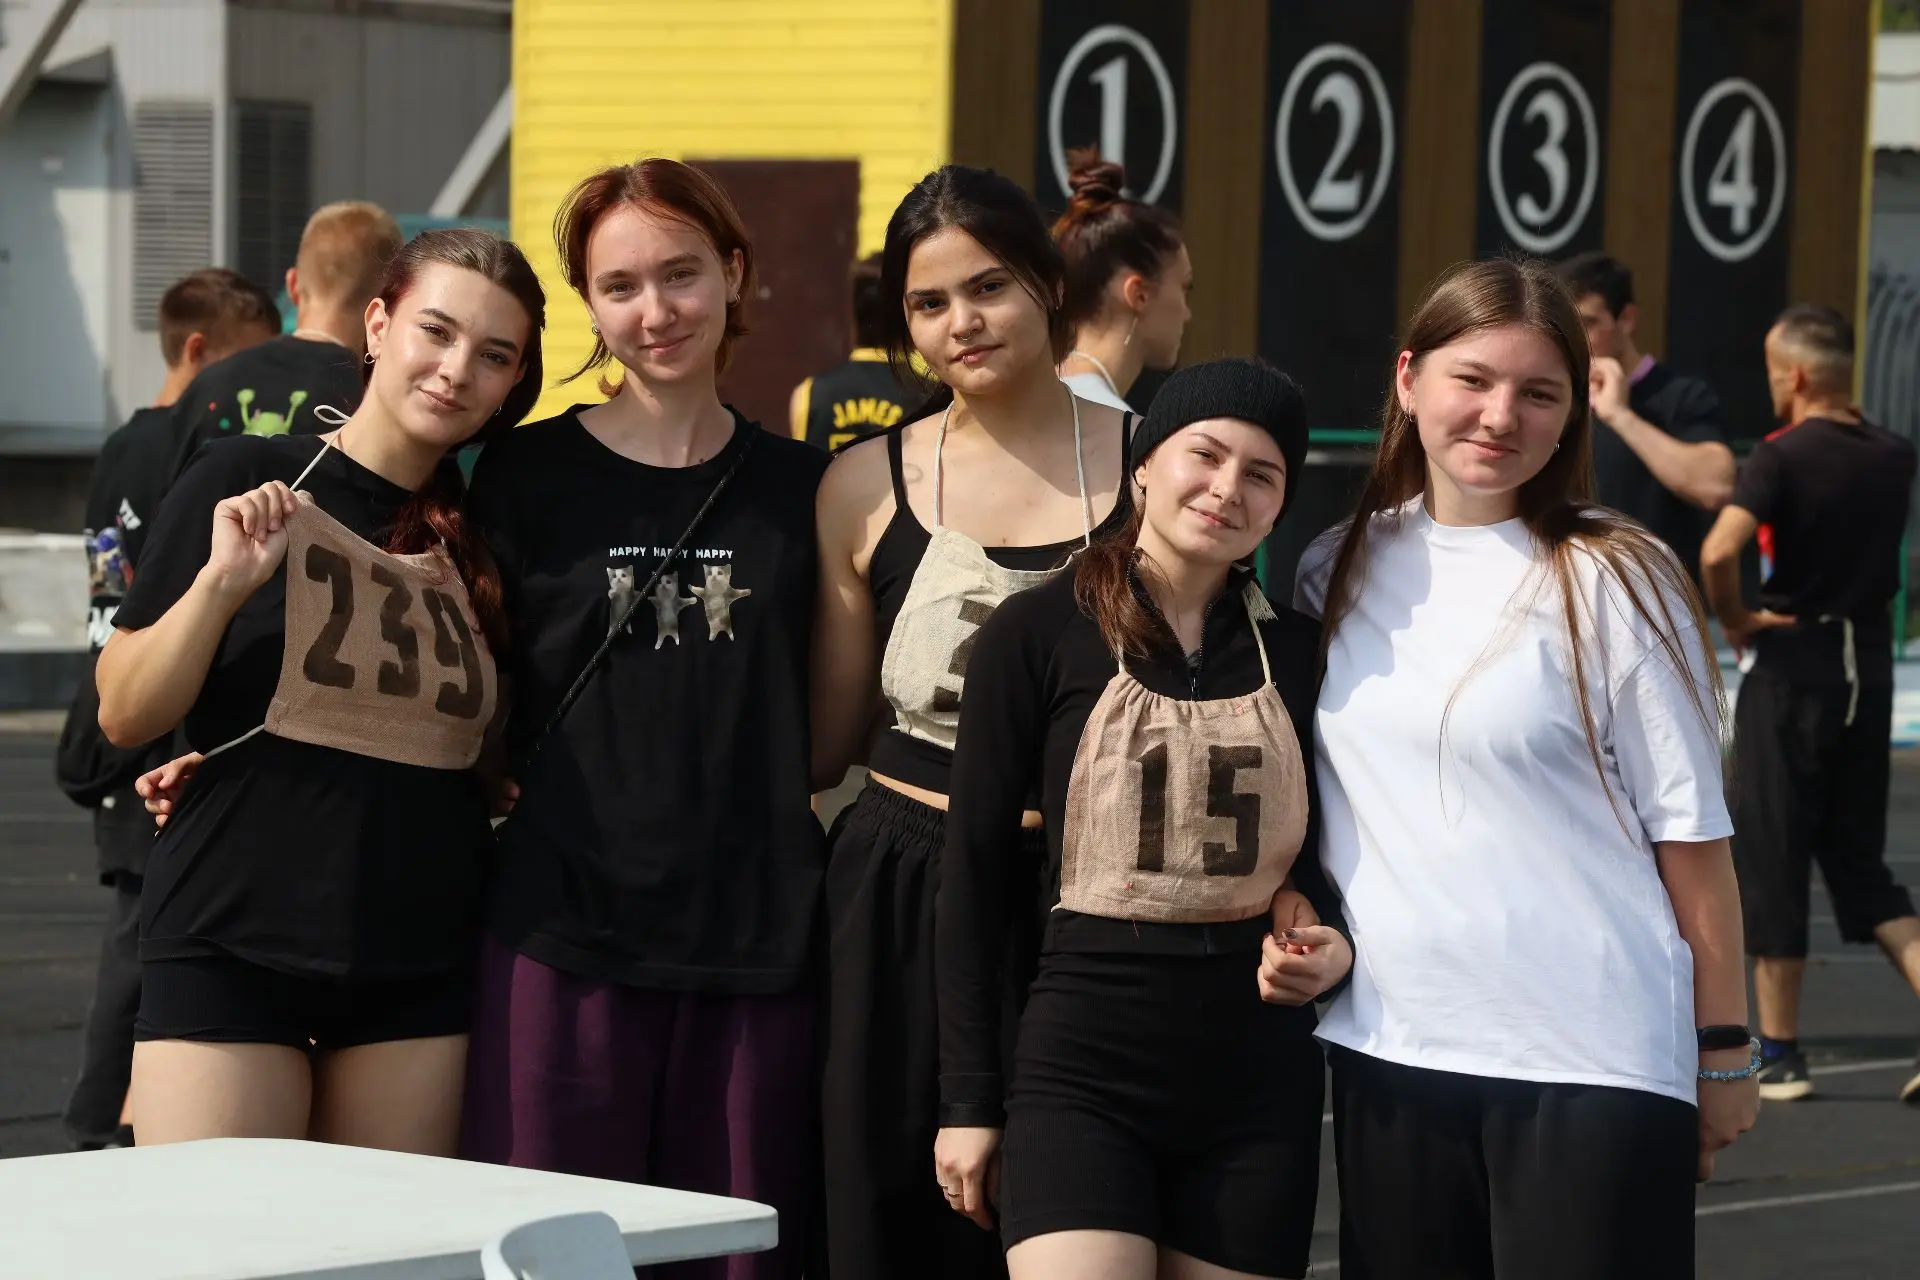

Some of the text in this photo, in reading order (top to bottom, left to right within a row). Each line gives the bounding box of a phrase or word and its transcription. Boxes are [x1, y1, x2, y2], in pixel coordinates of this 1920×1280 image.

[1088, 55, 1132, 200] 1
[1306, 71, 1363, 211] 2
[1517, 89, 1569, 226] 3
[1708, 105, 1757, 235] 4
[609, 546, 647, 558] HAPPY
[695, 548, 734, 560] HAPPY
[303, 543, 484, 720] 239
[1135, 740, 1263, 877] 15
